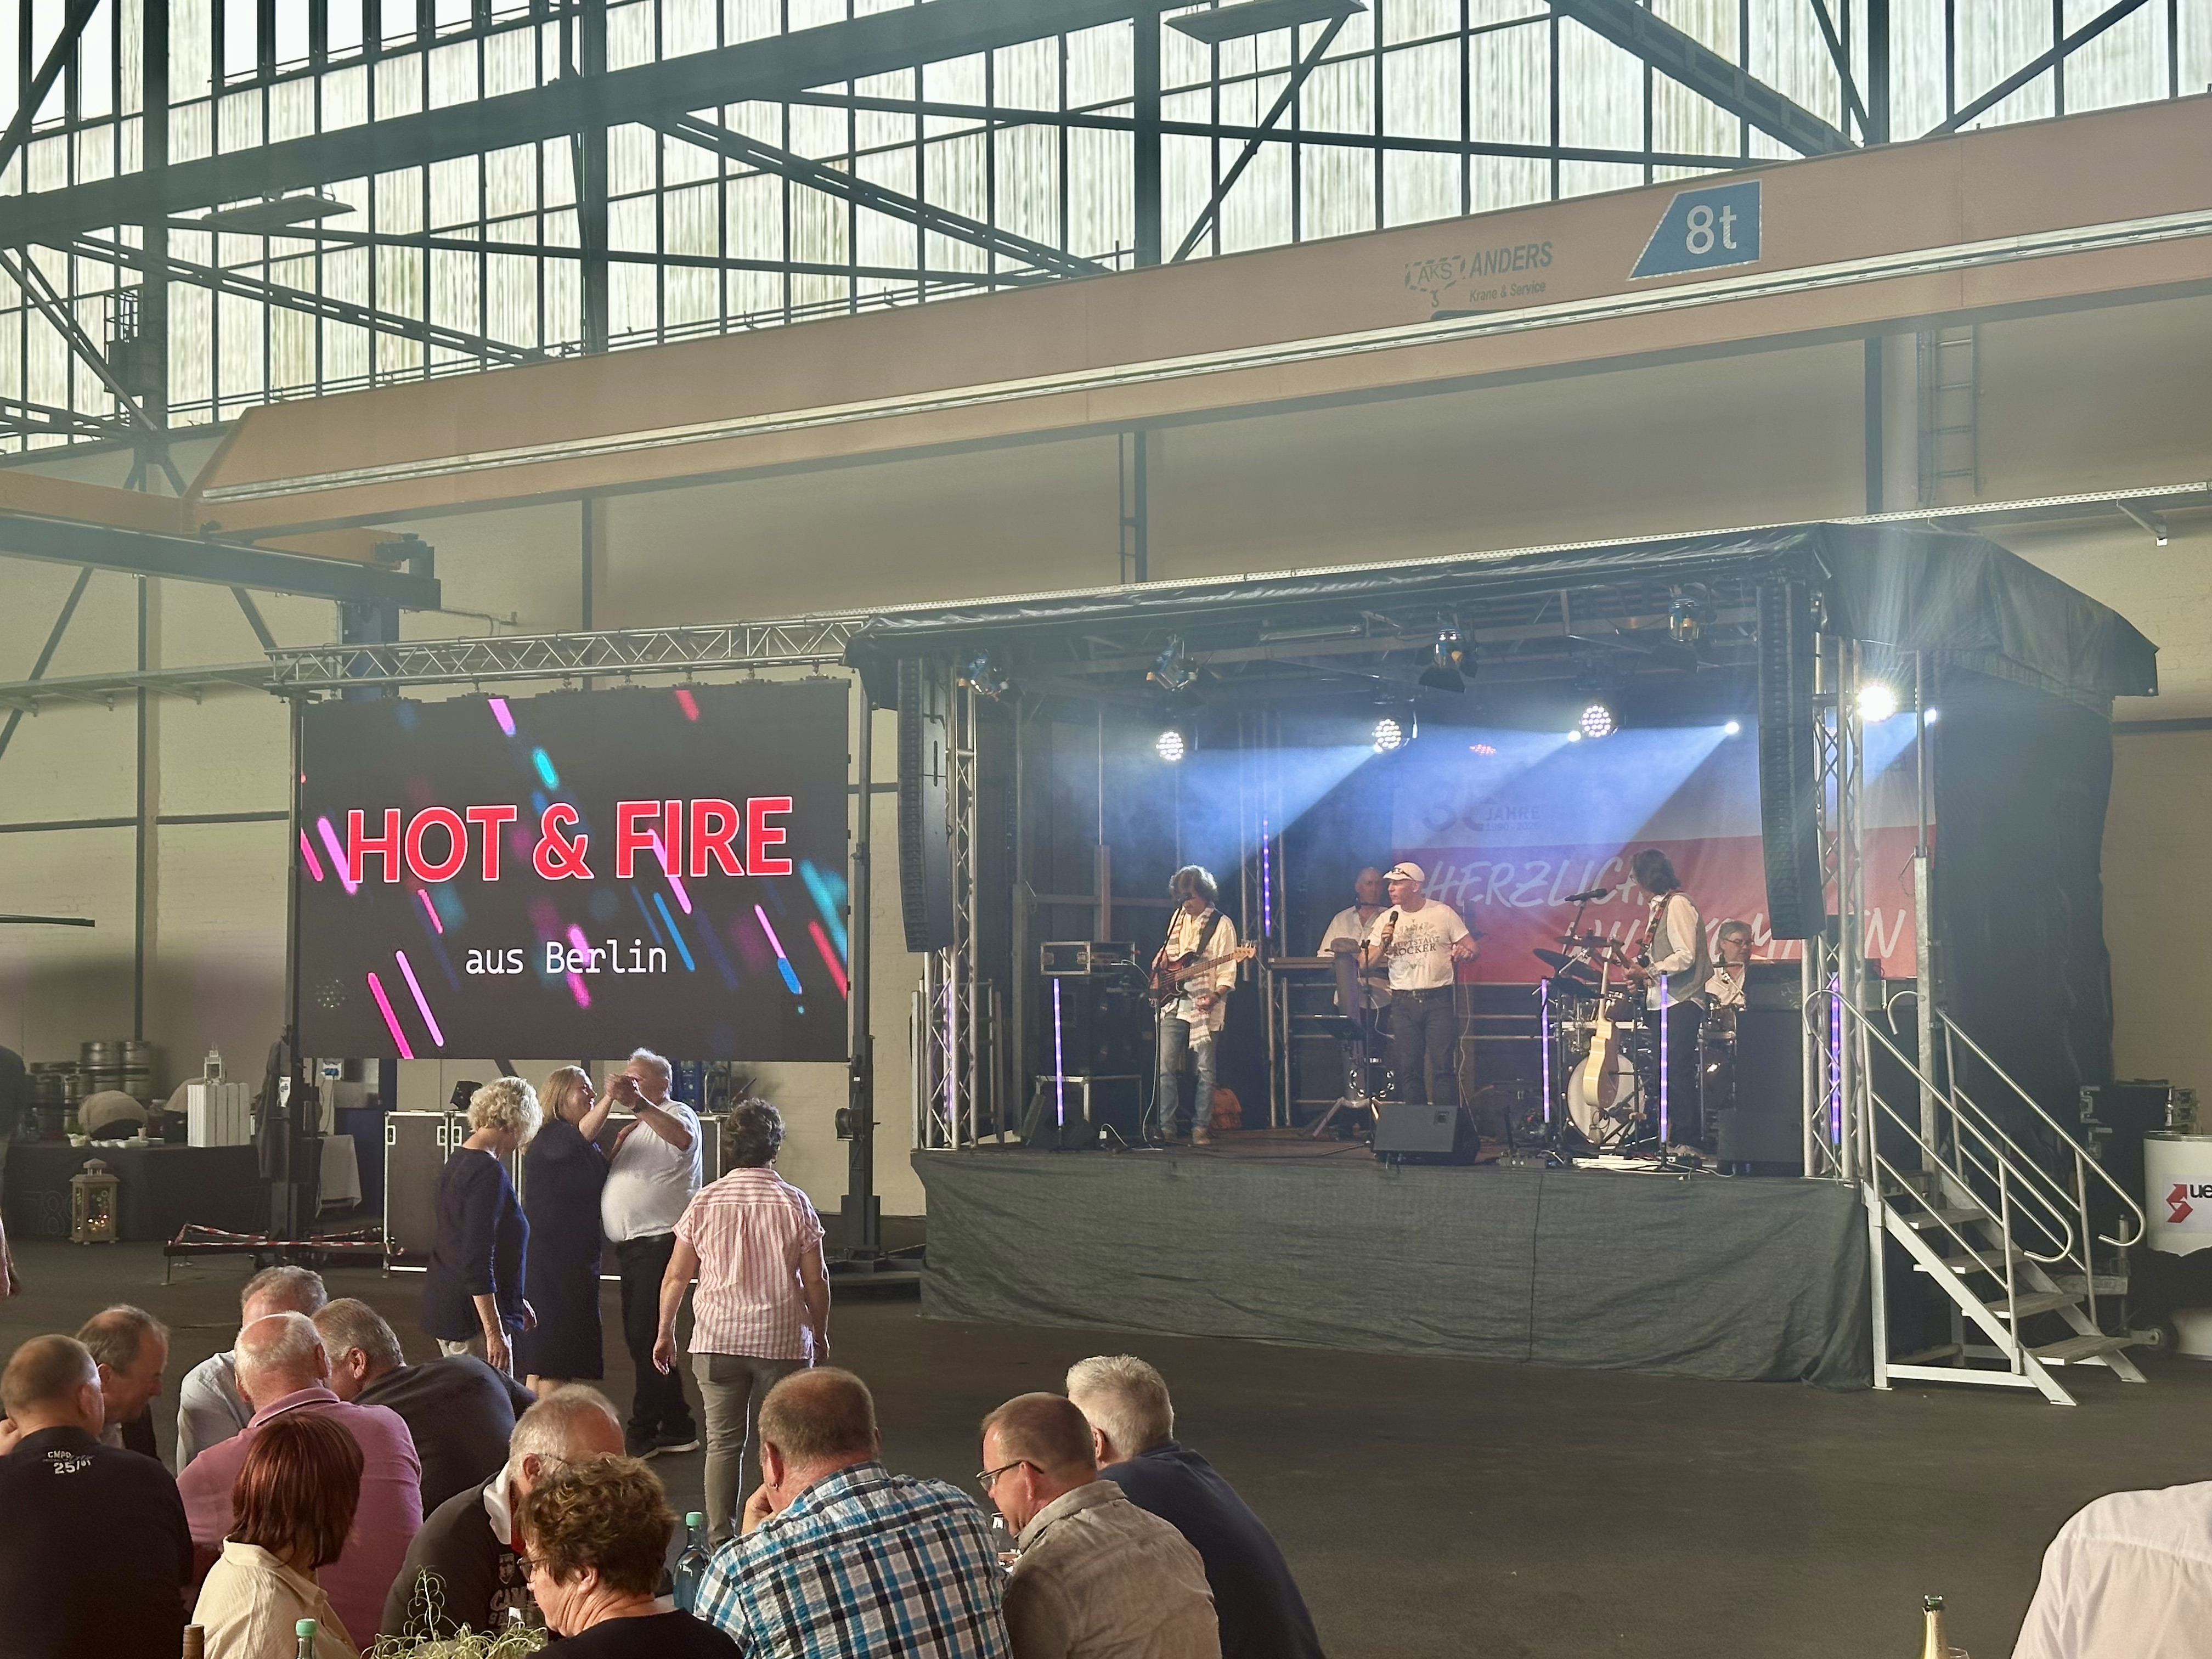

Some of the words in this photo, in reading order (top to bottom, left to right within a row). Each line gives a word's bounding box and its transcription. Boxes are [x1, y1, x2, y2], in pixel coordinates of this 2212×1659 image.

[1686, 205, 1737, 254] 8t
[1469, 241, 1553, 278] ANDERS
[1469, 289, 1497, 302] Krane
[1500, 284, 1507, 298] &
[1510, 280, 1547, 297] Service
[1485, 805, 1541, 821] JAHRE
[347, 805, 517, 883] HOT
[533, 803, 595, 881] &
[616, 796, 793, 878] FIRE
[466, 949, 524, 974] aus
[546, 939, 667, 974] Berlin
